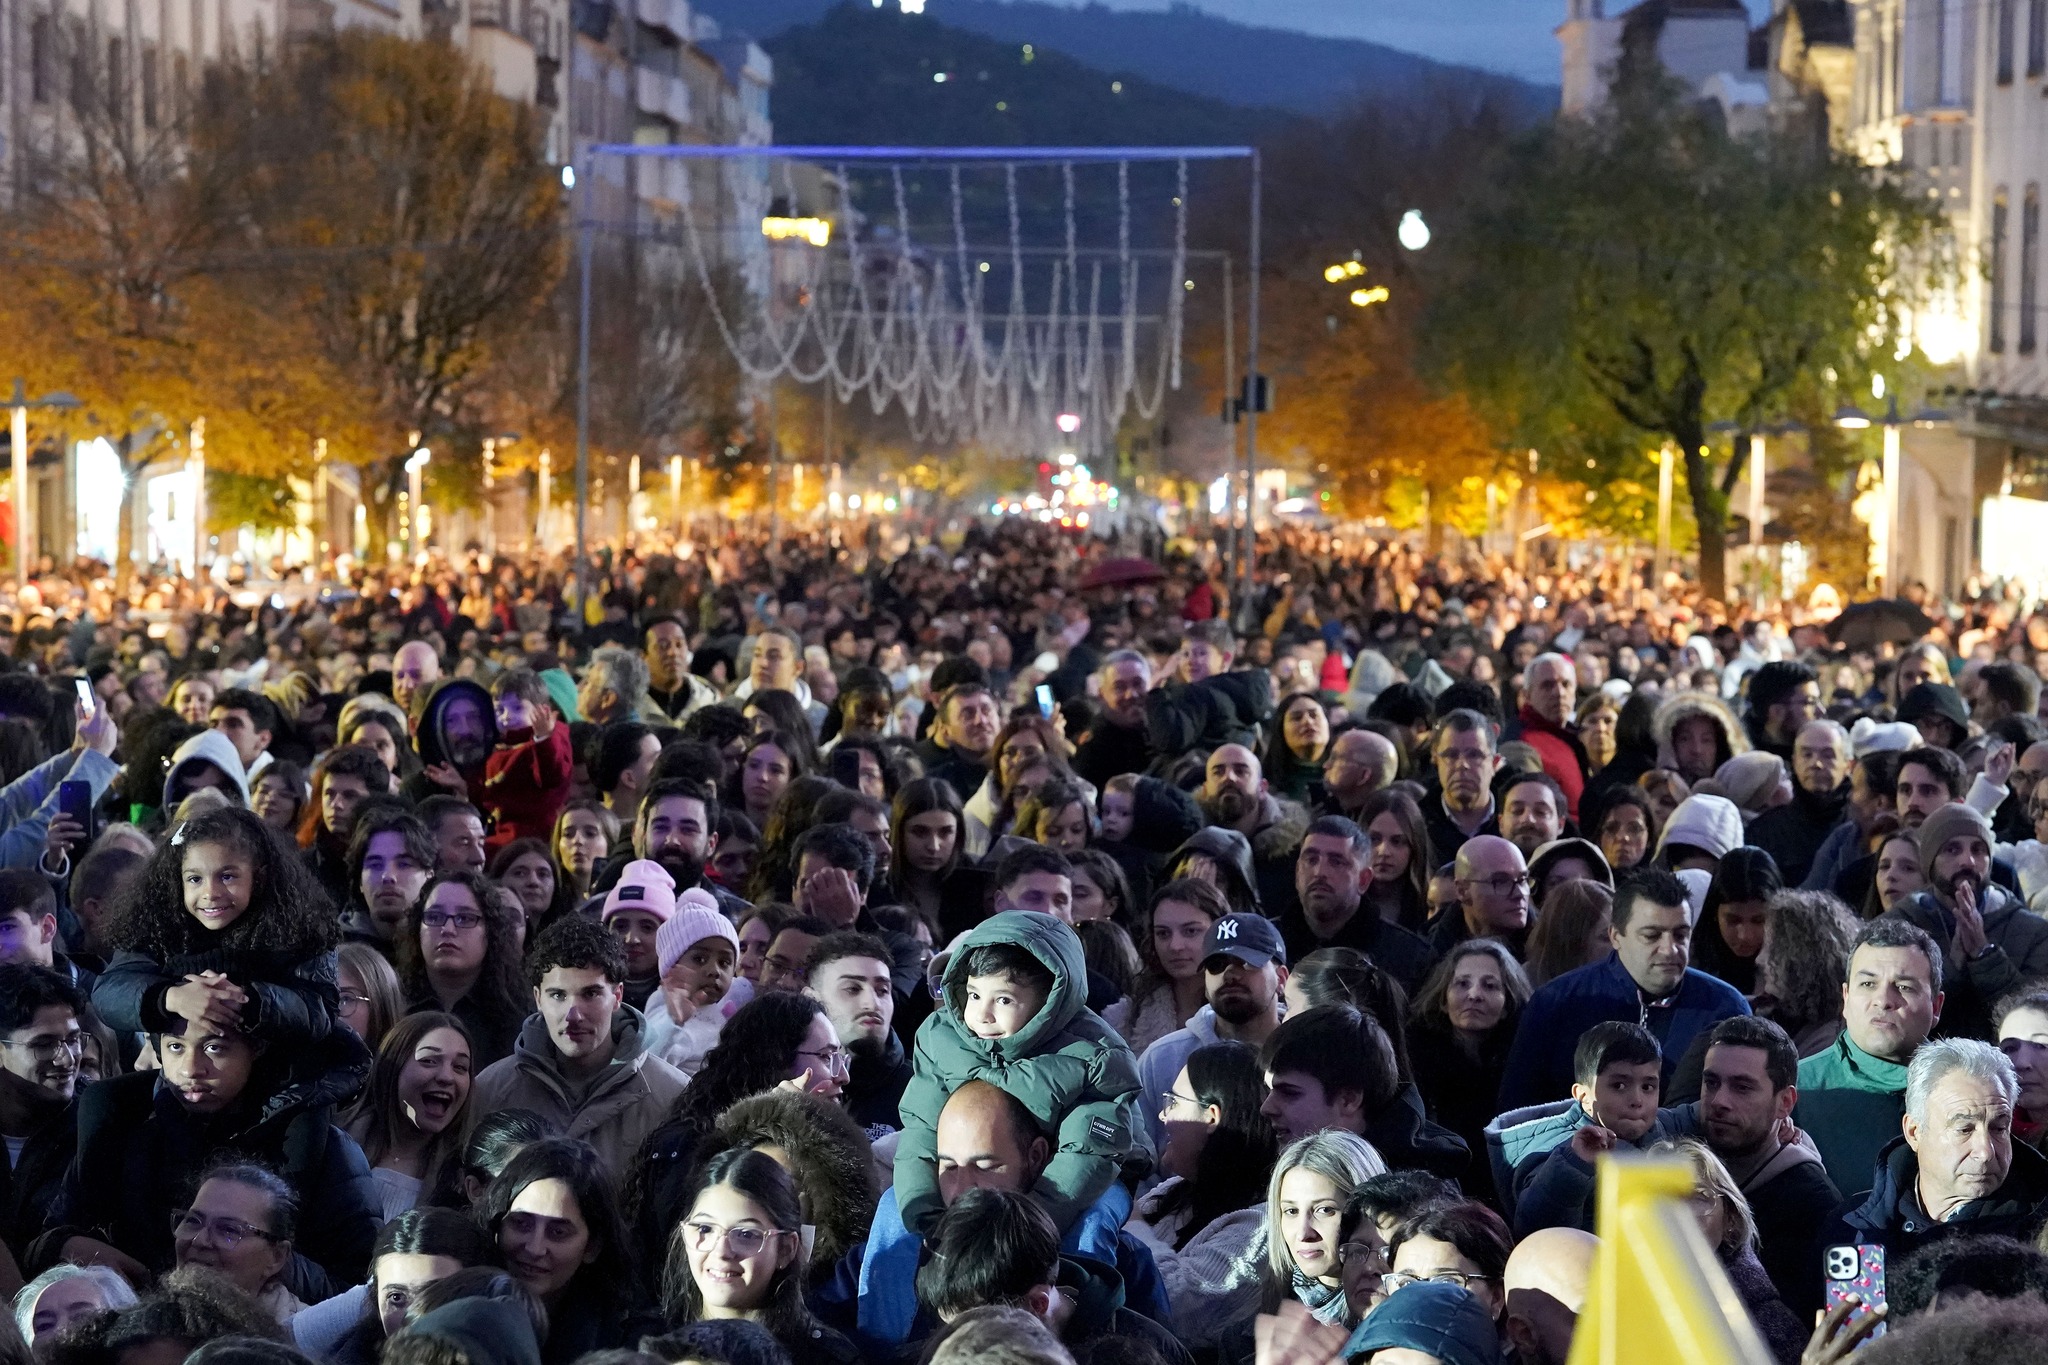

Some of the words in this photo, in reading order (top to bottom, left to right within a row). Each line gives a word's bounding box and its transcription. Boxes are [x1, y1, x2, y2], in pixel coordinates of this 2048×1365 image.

[1217, 919, 1239, 940] NY
[864, 1127, 885, 1135] ORTH
[871, 1122, 887, 1131] THE
